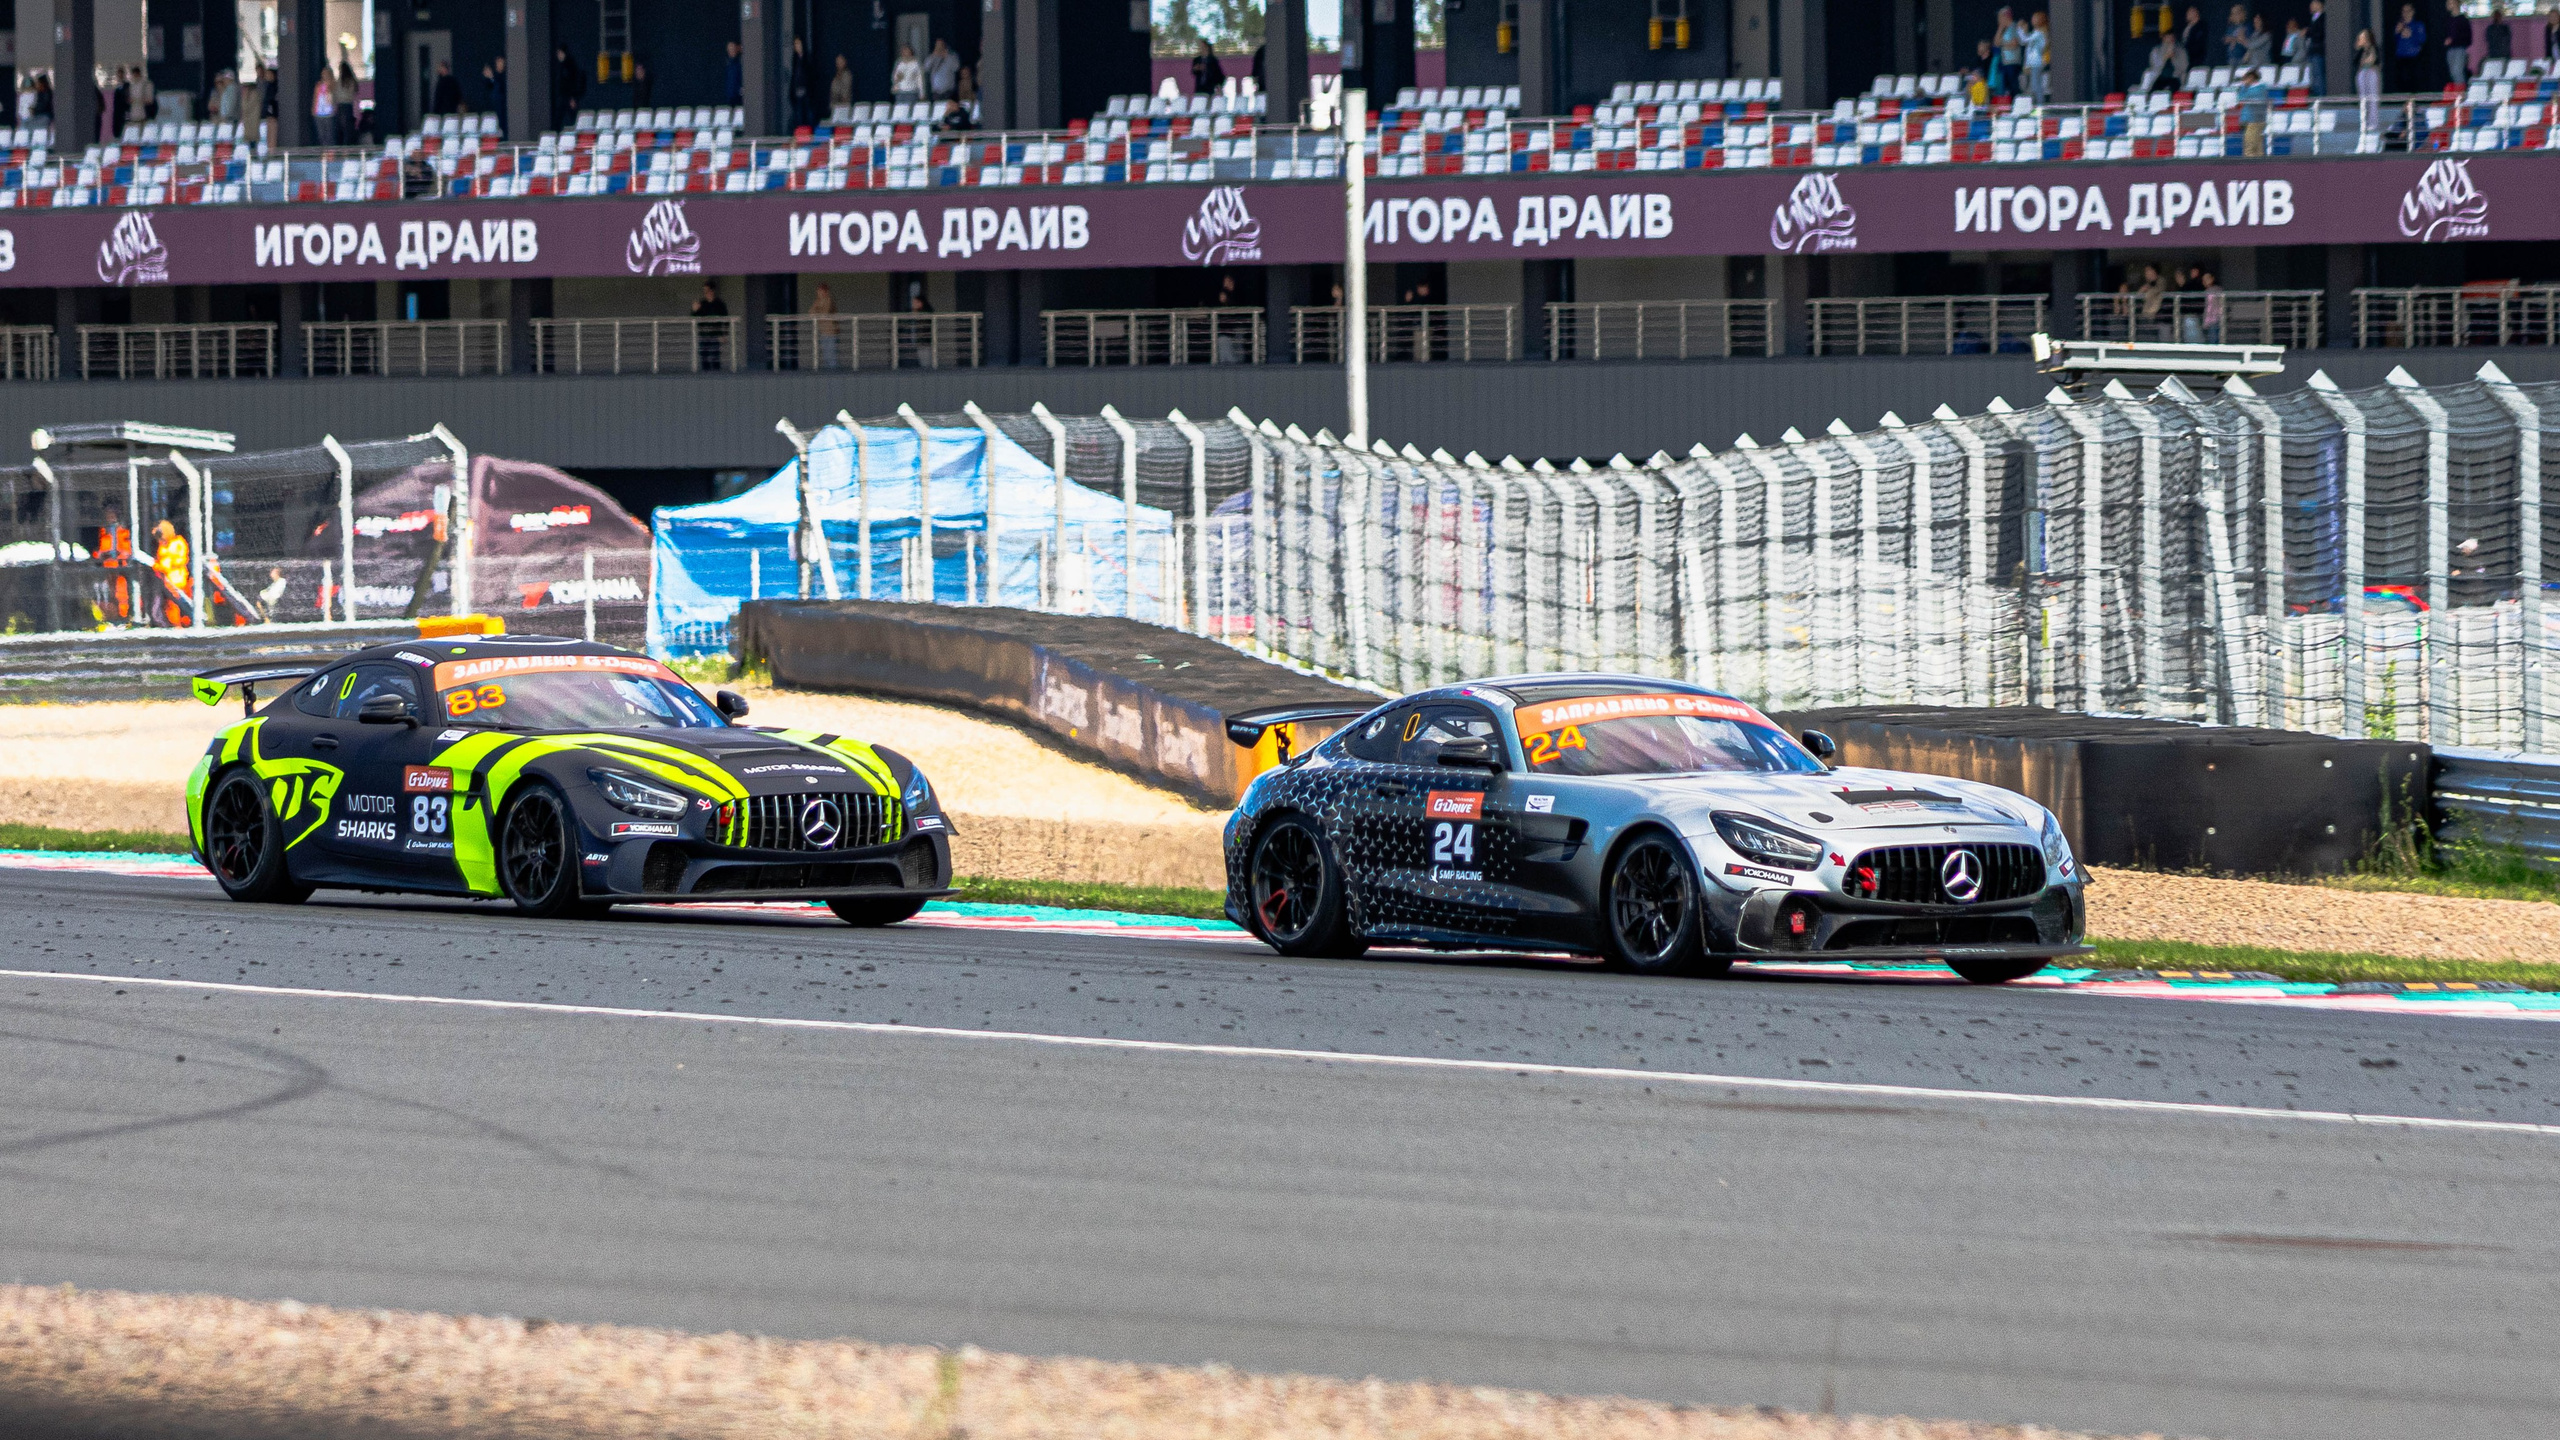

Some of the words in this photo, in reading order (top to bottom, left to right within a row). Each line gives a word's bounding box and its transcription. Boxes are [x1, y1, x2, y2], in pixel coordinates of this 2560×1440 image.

[1512, 194, 1673, 247] ДРАЙВ
[1954, 186, 2112, 233] ИГОРА
[2123, 179, 2295, 236] ДРАЙВ
[255, 223, 386, 267] ИГОРА
[396, 219, 539, 271] ДРАЙВ
[789, 210, 928, 255] ИГОРА
[938, 205, 1090, 258] ДРАЙВ
[454, 656, 577, 679] ЗАПРАВЛЕНО
[447, 684, 507, 716] 83
[1541, 698, 1669, 724] ЗАПРАВЛЕНО
[1523, 725, 1587, 766] 24
[743, 763, 791, 775] MOTOR
[791, 763, 847, 774] SHARKS
[348, 794, 396, 814] MOTOR
[413, 795, 448, 834] 83
[337, 819, 396, 841] SHARKS
[630, 824, 673, 833] YOKOHAMA
[1434, 822, 1474, 862] 24
[1438, 869, 1455, 880] SMP
[1456, 870, 1483, 882] RACING
[1743, 868, 1789, 883] YOKOHAMA
